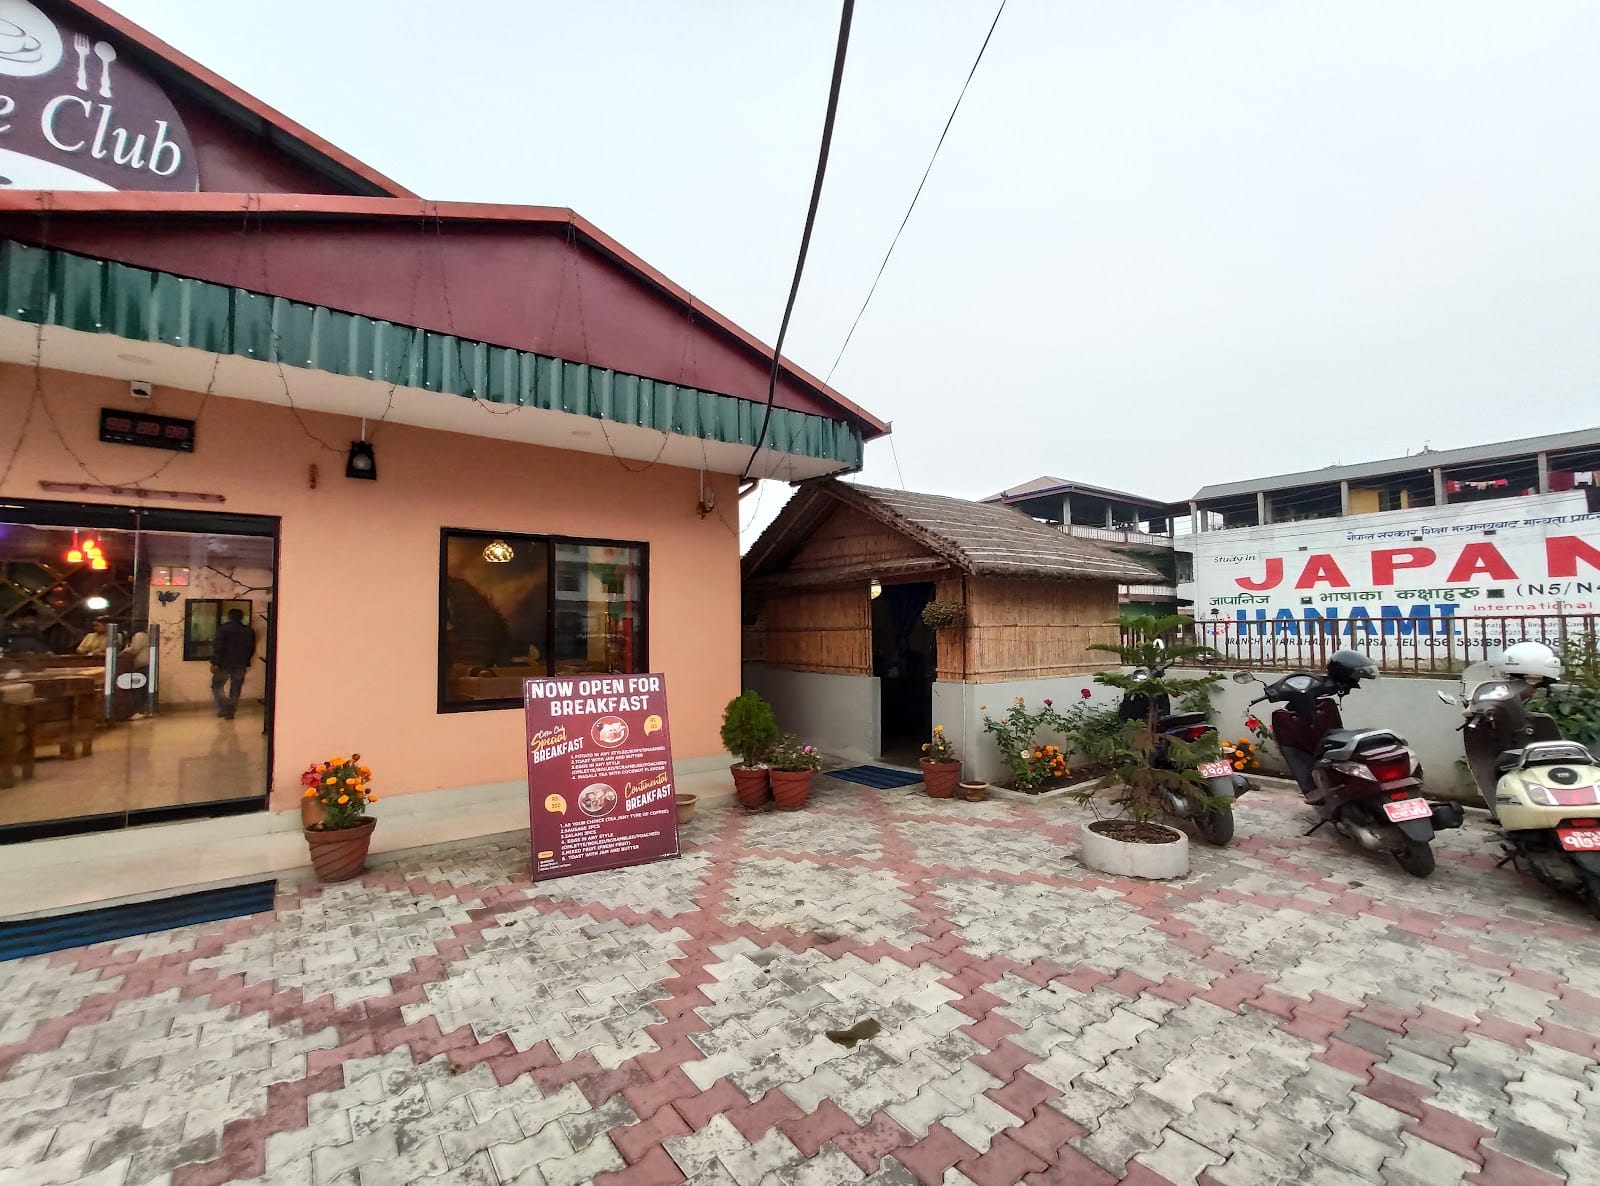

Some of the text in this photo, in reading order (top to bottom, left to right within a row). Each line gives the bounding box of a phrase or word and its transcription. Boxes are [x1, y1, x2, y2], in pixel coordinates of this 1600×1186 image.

[41, 95, 182, 176] Club
[1234, 535, 1600, 591] JAPAN
[1209, 593, 1271, 606] जापानिज
[1320, 590, 1383, 602] भाषाका
[531, 677, 660, 699] NOW OPEN FOR
[550, 695, 650, 717] BREAKFAST
[531, 730, 567, 753] Special
[533, 736, 584, 764] BREAKFAST
[625, 783, 671, 811] BREAKFAST
